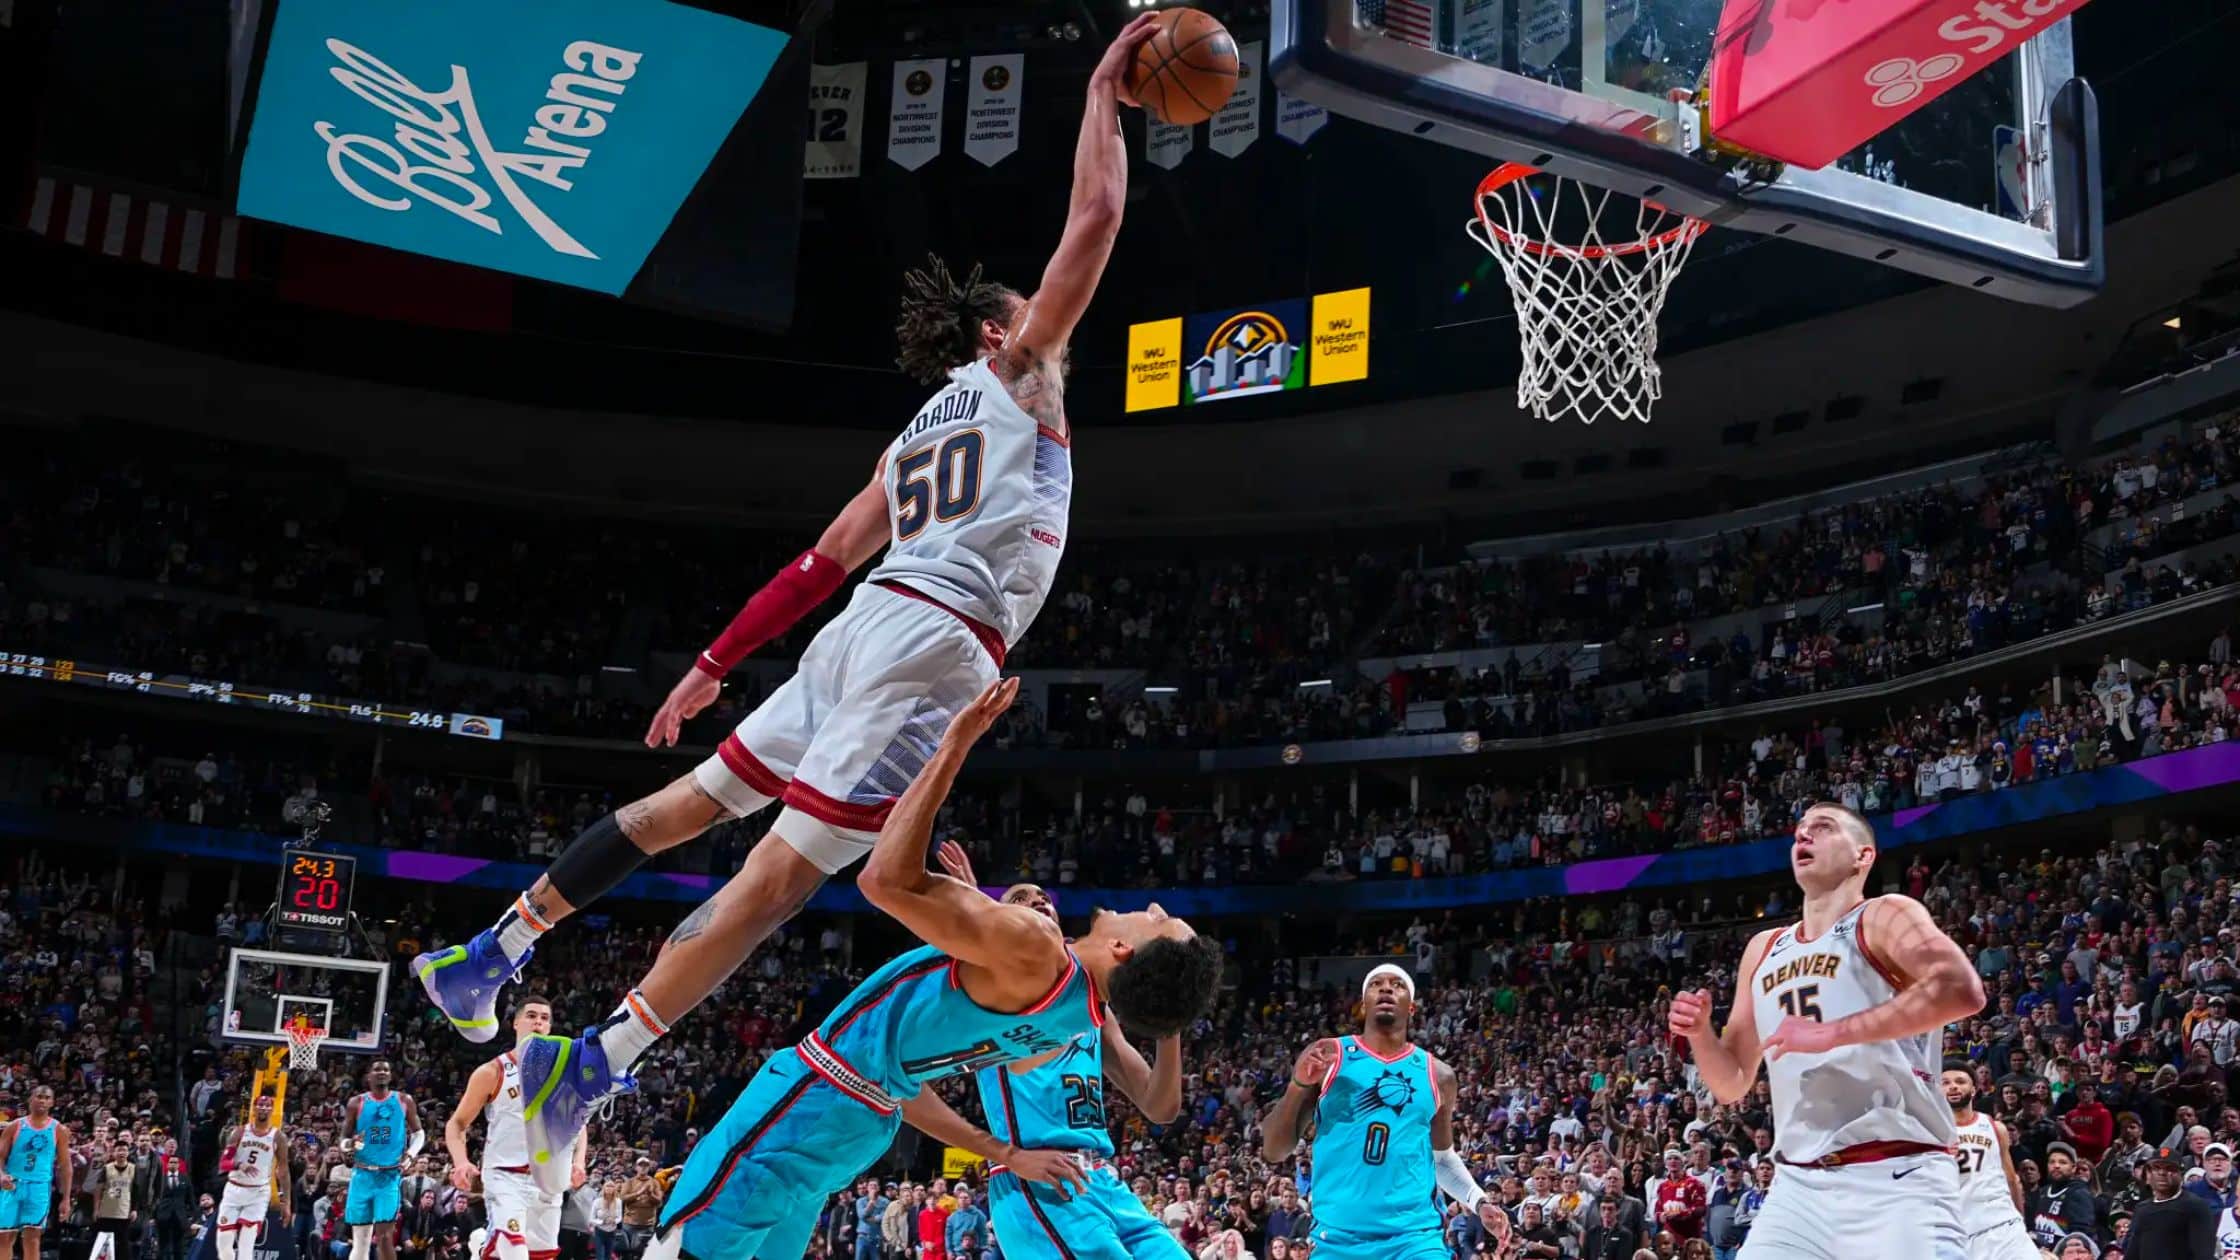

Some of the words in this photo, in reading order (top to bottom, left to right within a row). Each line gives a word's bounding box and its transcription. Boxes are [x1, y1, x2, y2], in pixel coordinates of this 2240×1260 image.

[314, 37, 515, 236] Ball
[501, 39, 643, 192] Arena
[1315, 329, 1366, 346] Western
[1322, 341, 1359, 356] Union
[1130, 358, 1177, 373] Western
[1137, 370, 1170, 384] Union
[895, 427, 985, 542] 50
[1030, 527, 1062, 549] NUGGETS
[350, 704, 372, 717] FLS
[293, 857, 336, 878] 24.3
[294, 876, 340, 910] 20
[299, 913, 345, 926] TISSOT
[1761, 953, 1842, 995] DENVER
[1062, 1074, 1105, 1130] 25
[369, 1126, 392, 1145] 22
[1363, 1121, 1390, 1166] 0
[1958, 1134, 1992, 1149] NVER
[24, 1154, 36, 1172] 3
[247, 1151, 258, 1165] 5
[1956, 1148, 1985, 1173] 27
